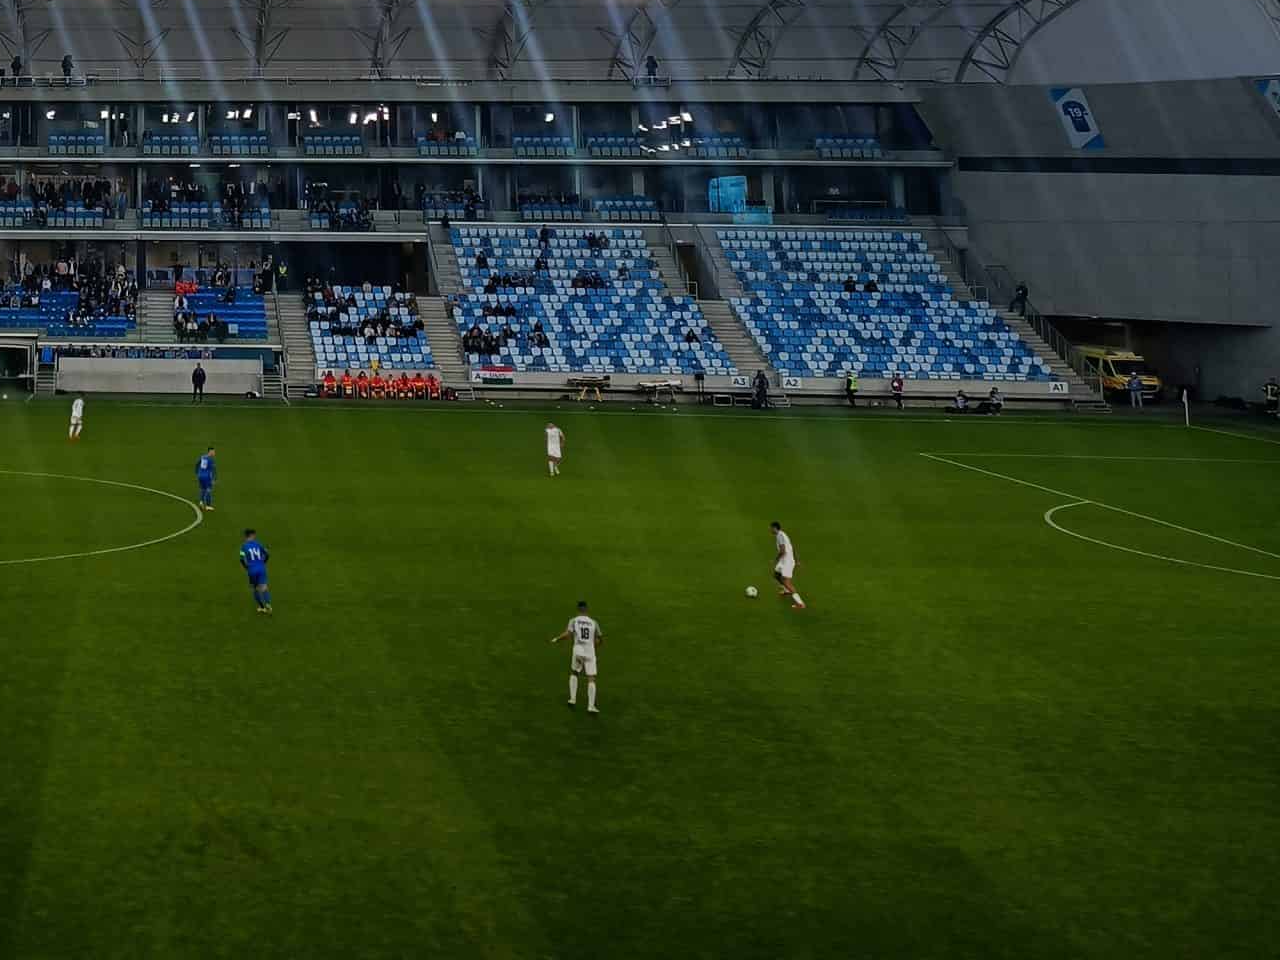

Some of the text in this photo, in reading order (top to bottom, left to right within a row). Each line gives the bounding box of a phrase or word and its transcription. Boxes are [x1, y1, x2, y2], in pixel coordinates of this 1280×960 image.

[733, 377, 746, 386] A3
[785, 378, 799, 387] A2
[248, 547, 261, 561] 14
